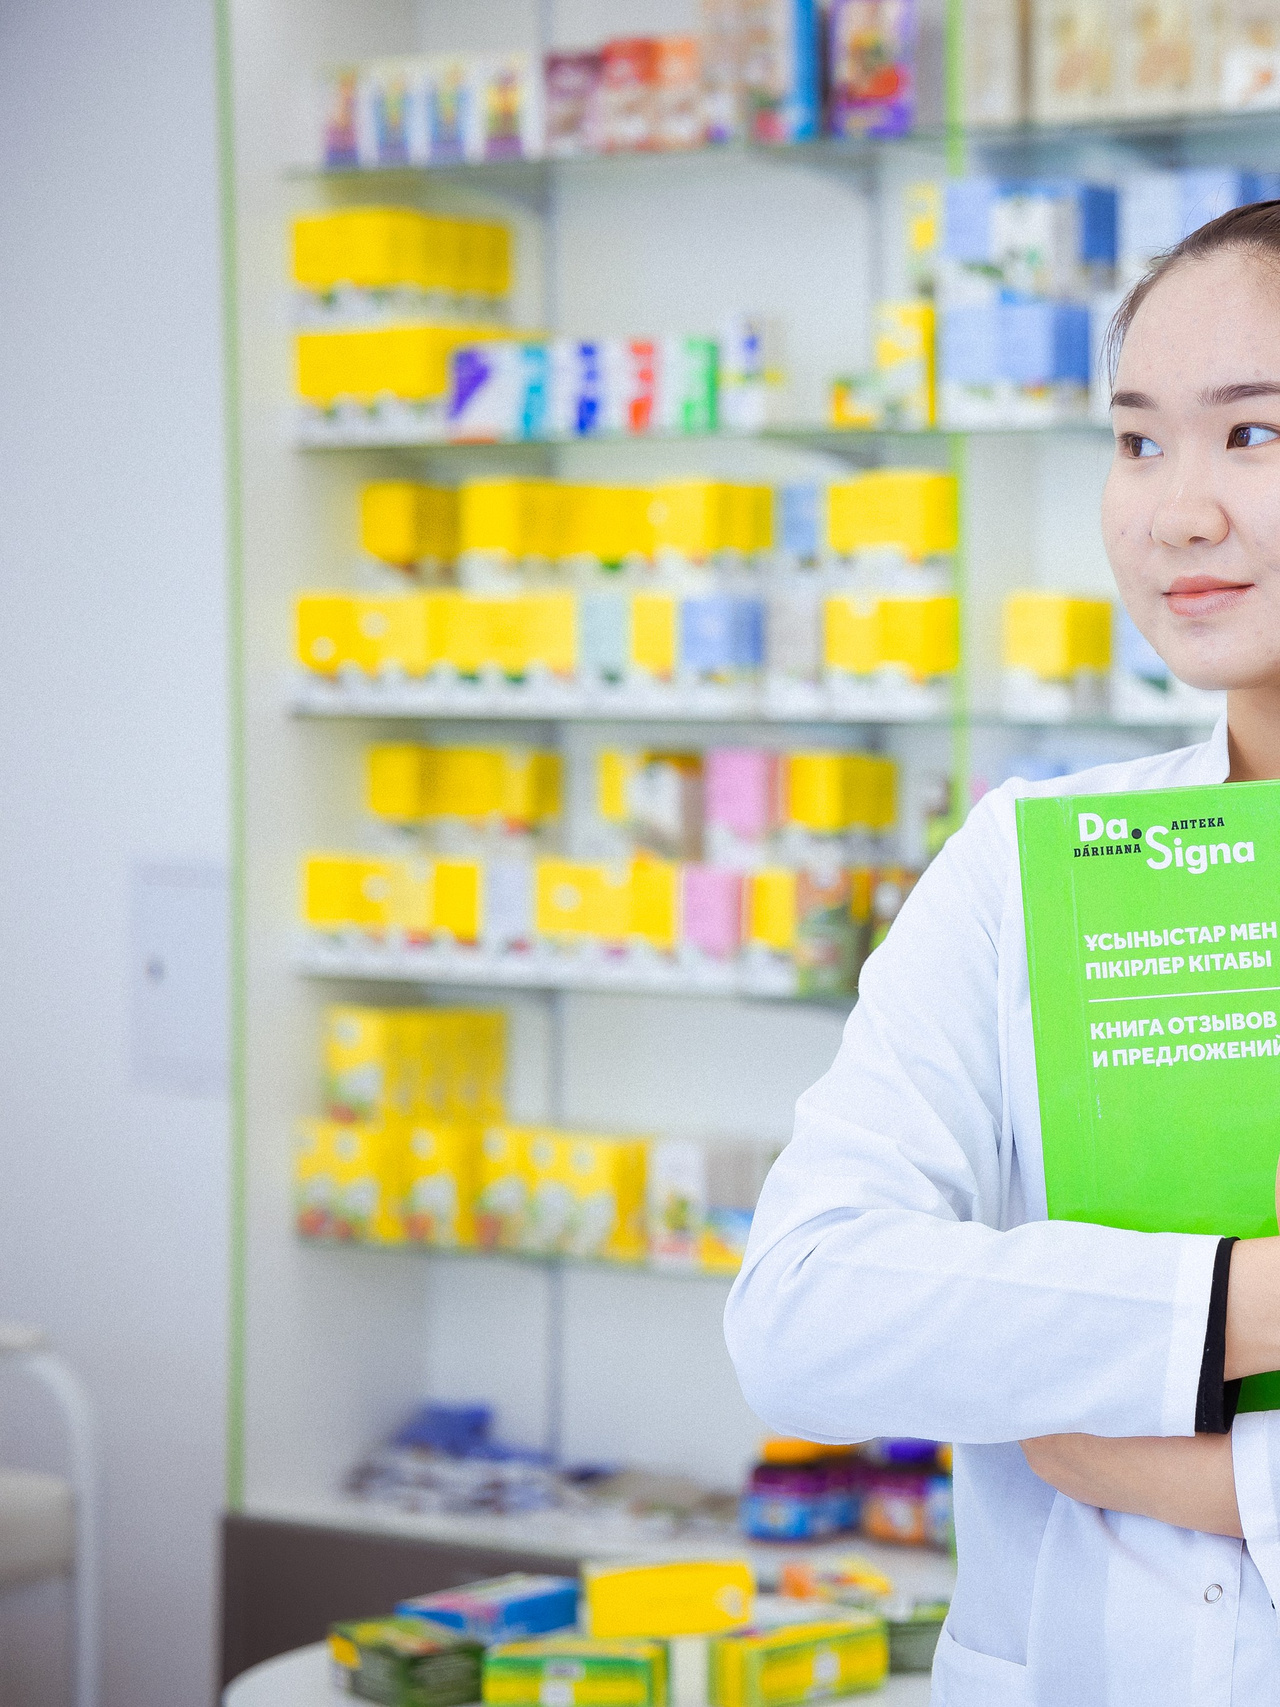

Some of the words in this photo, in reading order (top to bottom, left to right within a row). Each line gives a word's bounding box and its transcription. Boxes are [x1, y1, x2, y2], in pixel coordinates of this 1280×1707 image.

[1171, 817, 1225, 831] АПТЕКА
[1073, 843, 1142, 858] DÁRIHANA
[1145, 825, 1256, 875] Signa
[1083, 925, 1226, 951] ҰСЫНЫСТАР
[1230, 921, 1278, 942] МЕН
[1085, 956, 1185, 980] ПІКІРЛЕР
[1189, 950, 1272, 973] КІТАБЫ
[1090, 1018, 1165, 1040] КНИГА
[1168, 1011, 1278, 1035] ОТЗЫВОВ
[1092, 1050, 1109, 1068] И
